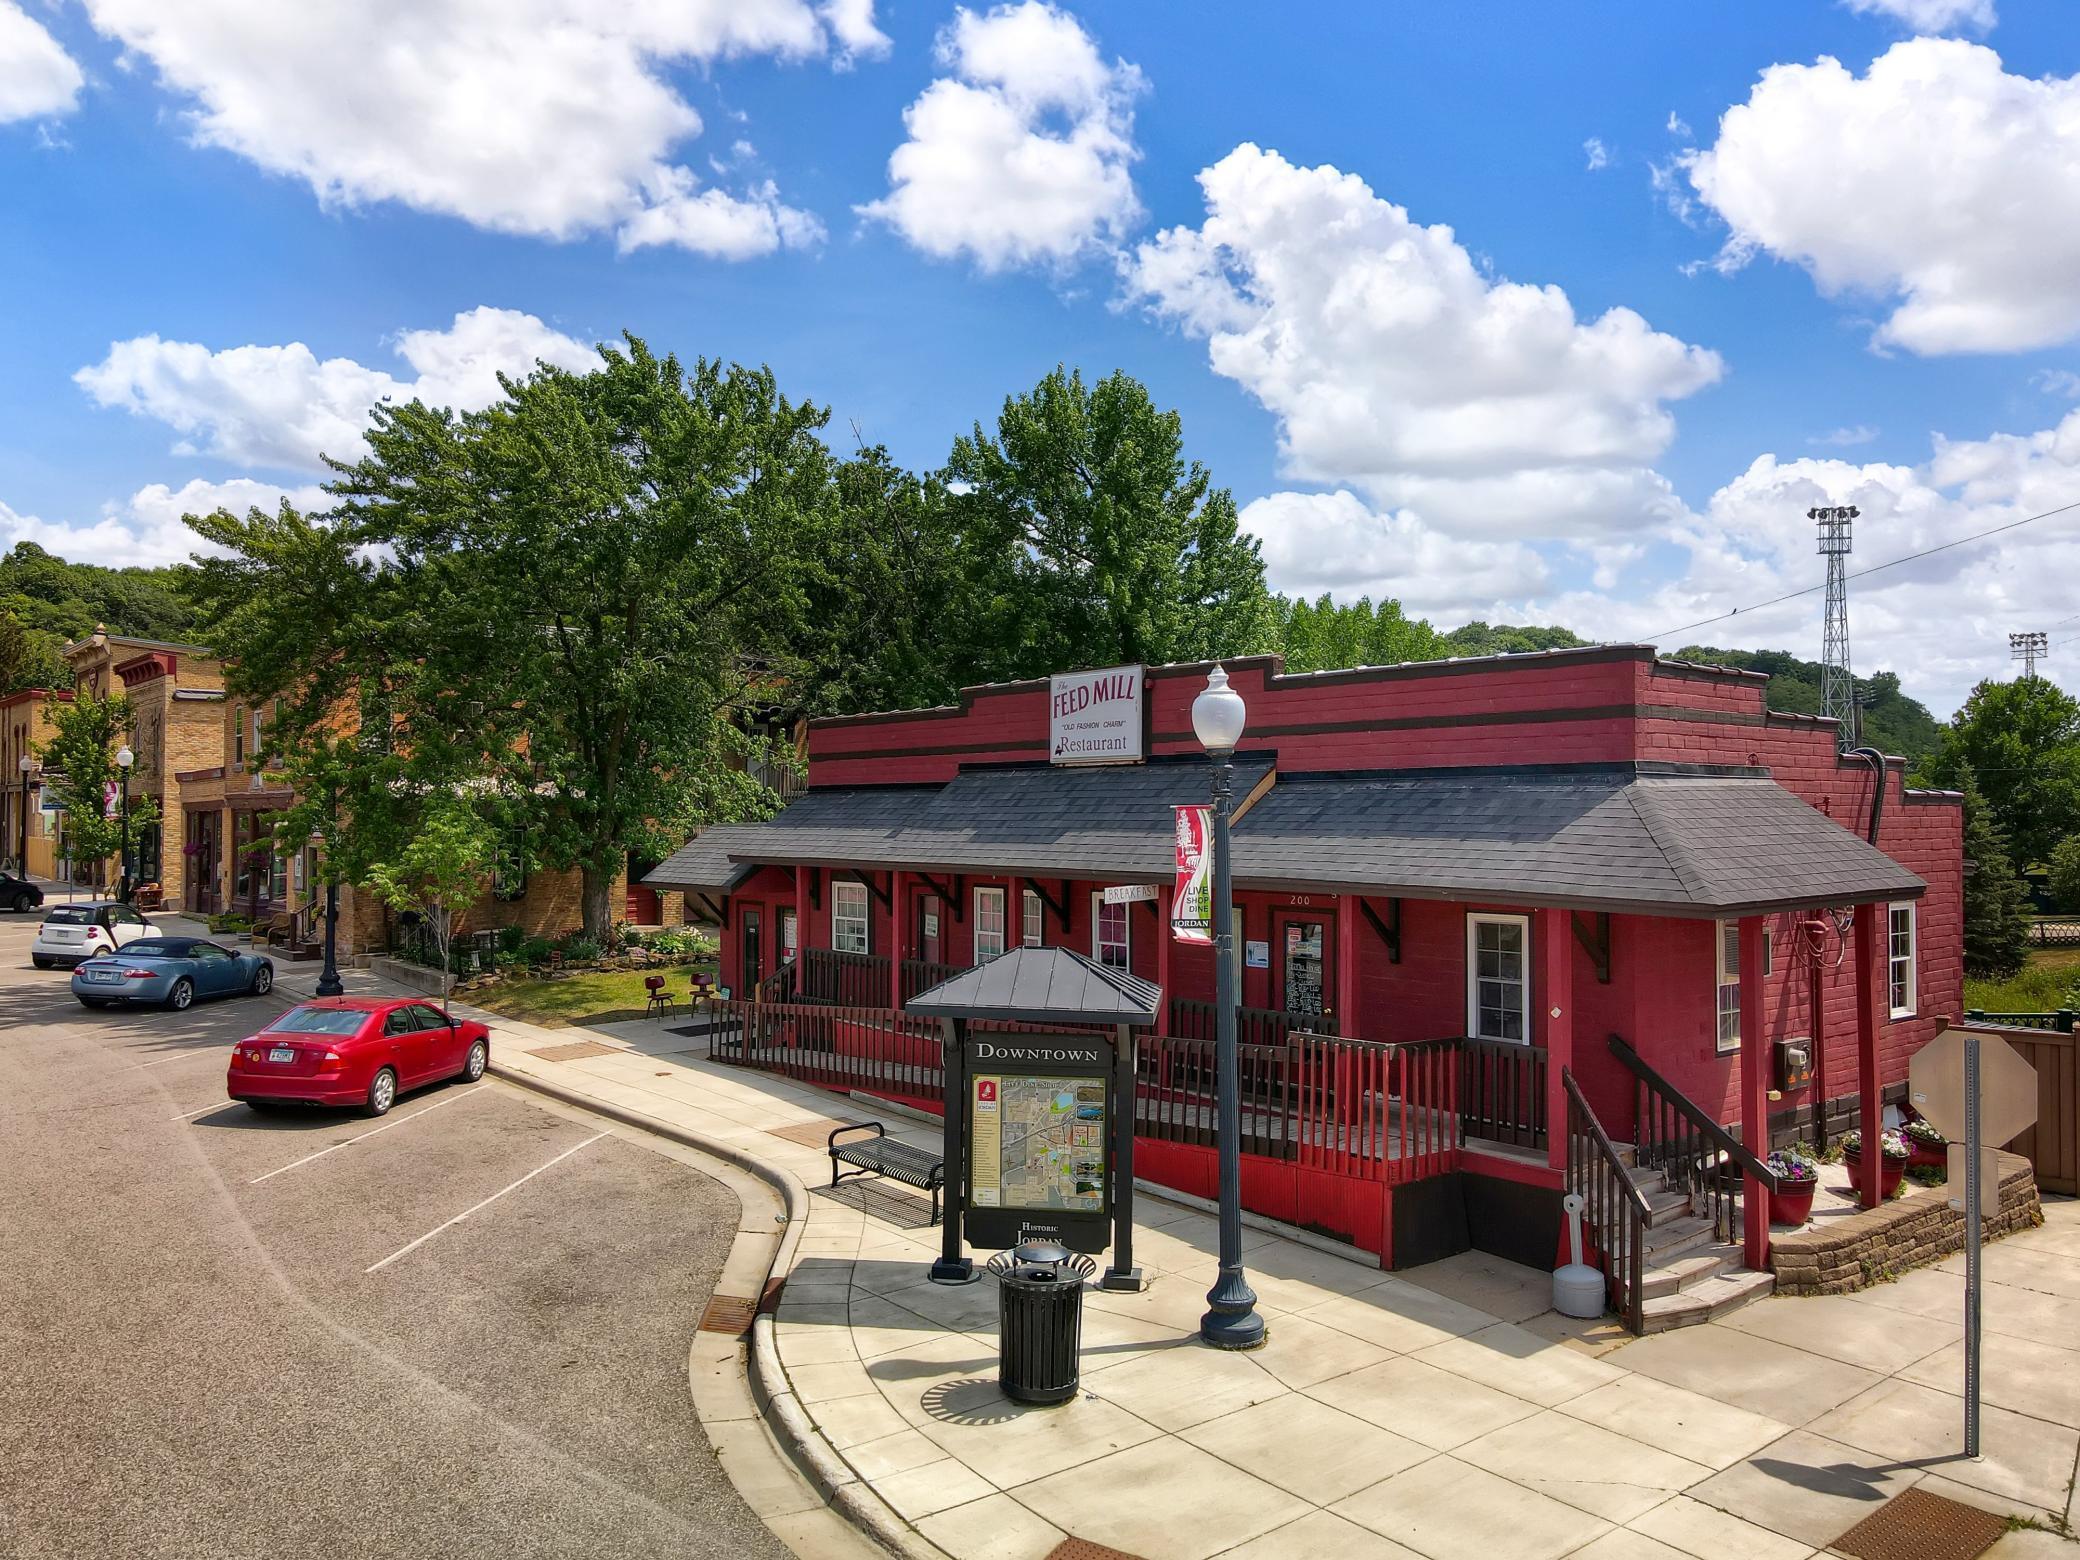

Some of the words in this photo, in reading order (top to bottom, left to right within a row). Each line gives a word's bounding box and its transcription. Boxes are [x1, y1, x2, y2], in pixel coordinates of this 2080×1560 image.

[1053, 685, 1090, 719] FEED
[1092, 675, 1135, 705] MILL
[1076, 721, 1100, 730] FASHION
[1060, 736, 1127, 753] Restaurant
[1108, 885, 1157, 901] BREAKFAST
[1188, 886, 1209, 895] LIVE
[1290, 896, 1310, 905] 200
[1189, 905, 1209, 913] DINE
[976, 1043, 1098, 1061] DOWNTOWN
[1023, 1221, 1059, 1232] HISTORIC
